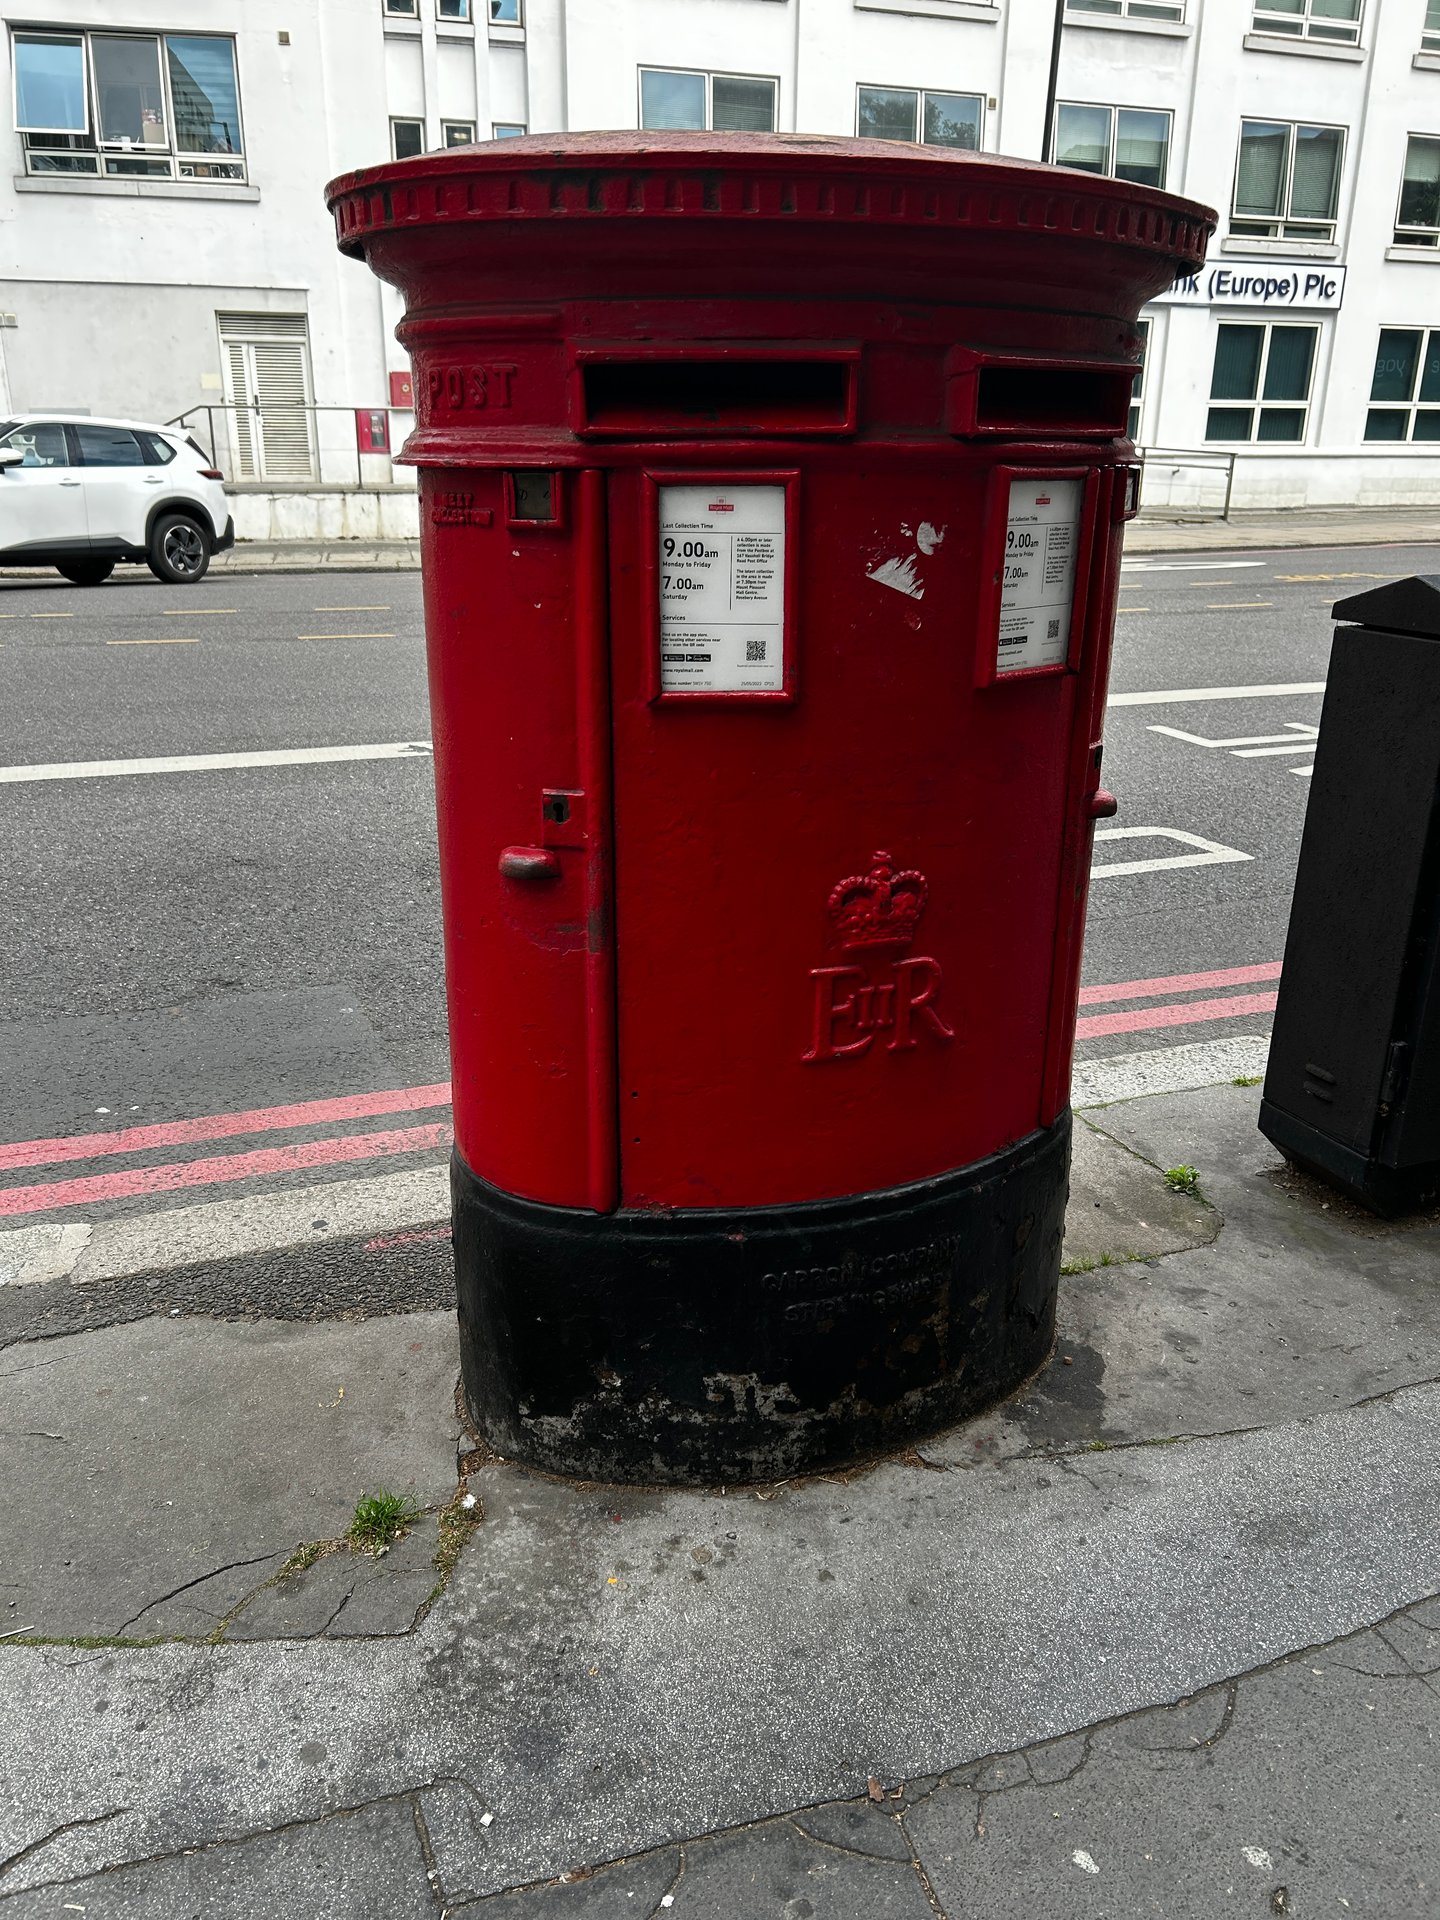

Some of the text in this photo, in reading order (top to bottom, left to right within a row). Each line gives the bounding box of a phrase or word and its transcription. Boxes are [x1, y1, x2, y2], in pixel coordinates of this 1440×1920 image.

[1168, 269, 1336, 303] nk (Europe) Plc
[428, 364, 516, 409] POST
[663, 538, 719, 558] 9.00am
[1007, 530, 1039, 549] 9.00am
[1004, 566, 1028, 579] 7.00am
[662, 576, 704, 590] 7.00am
